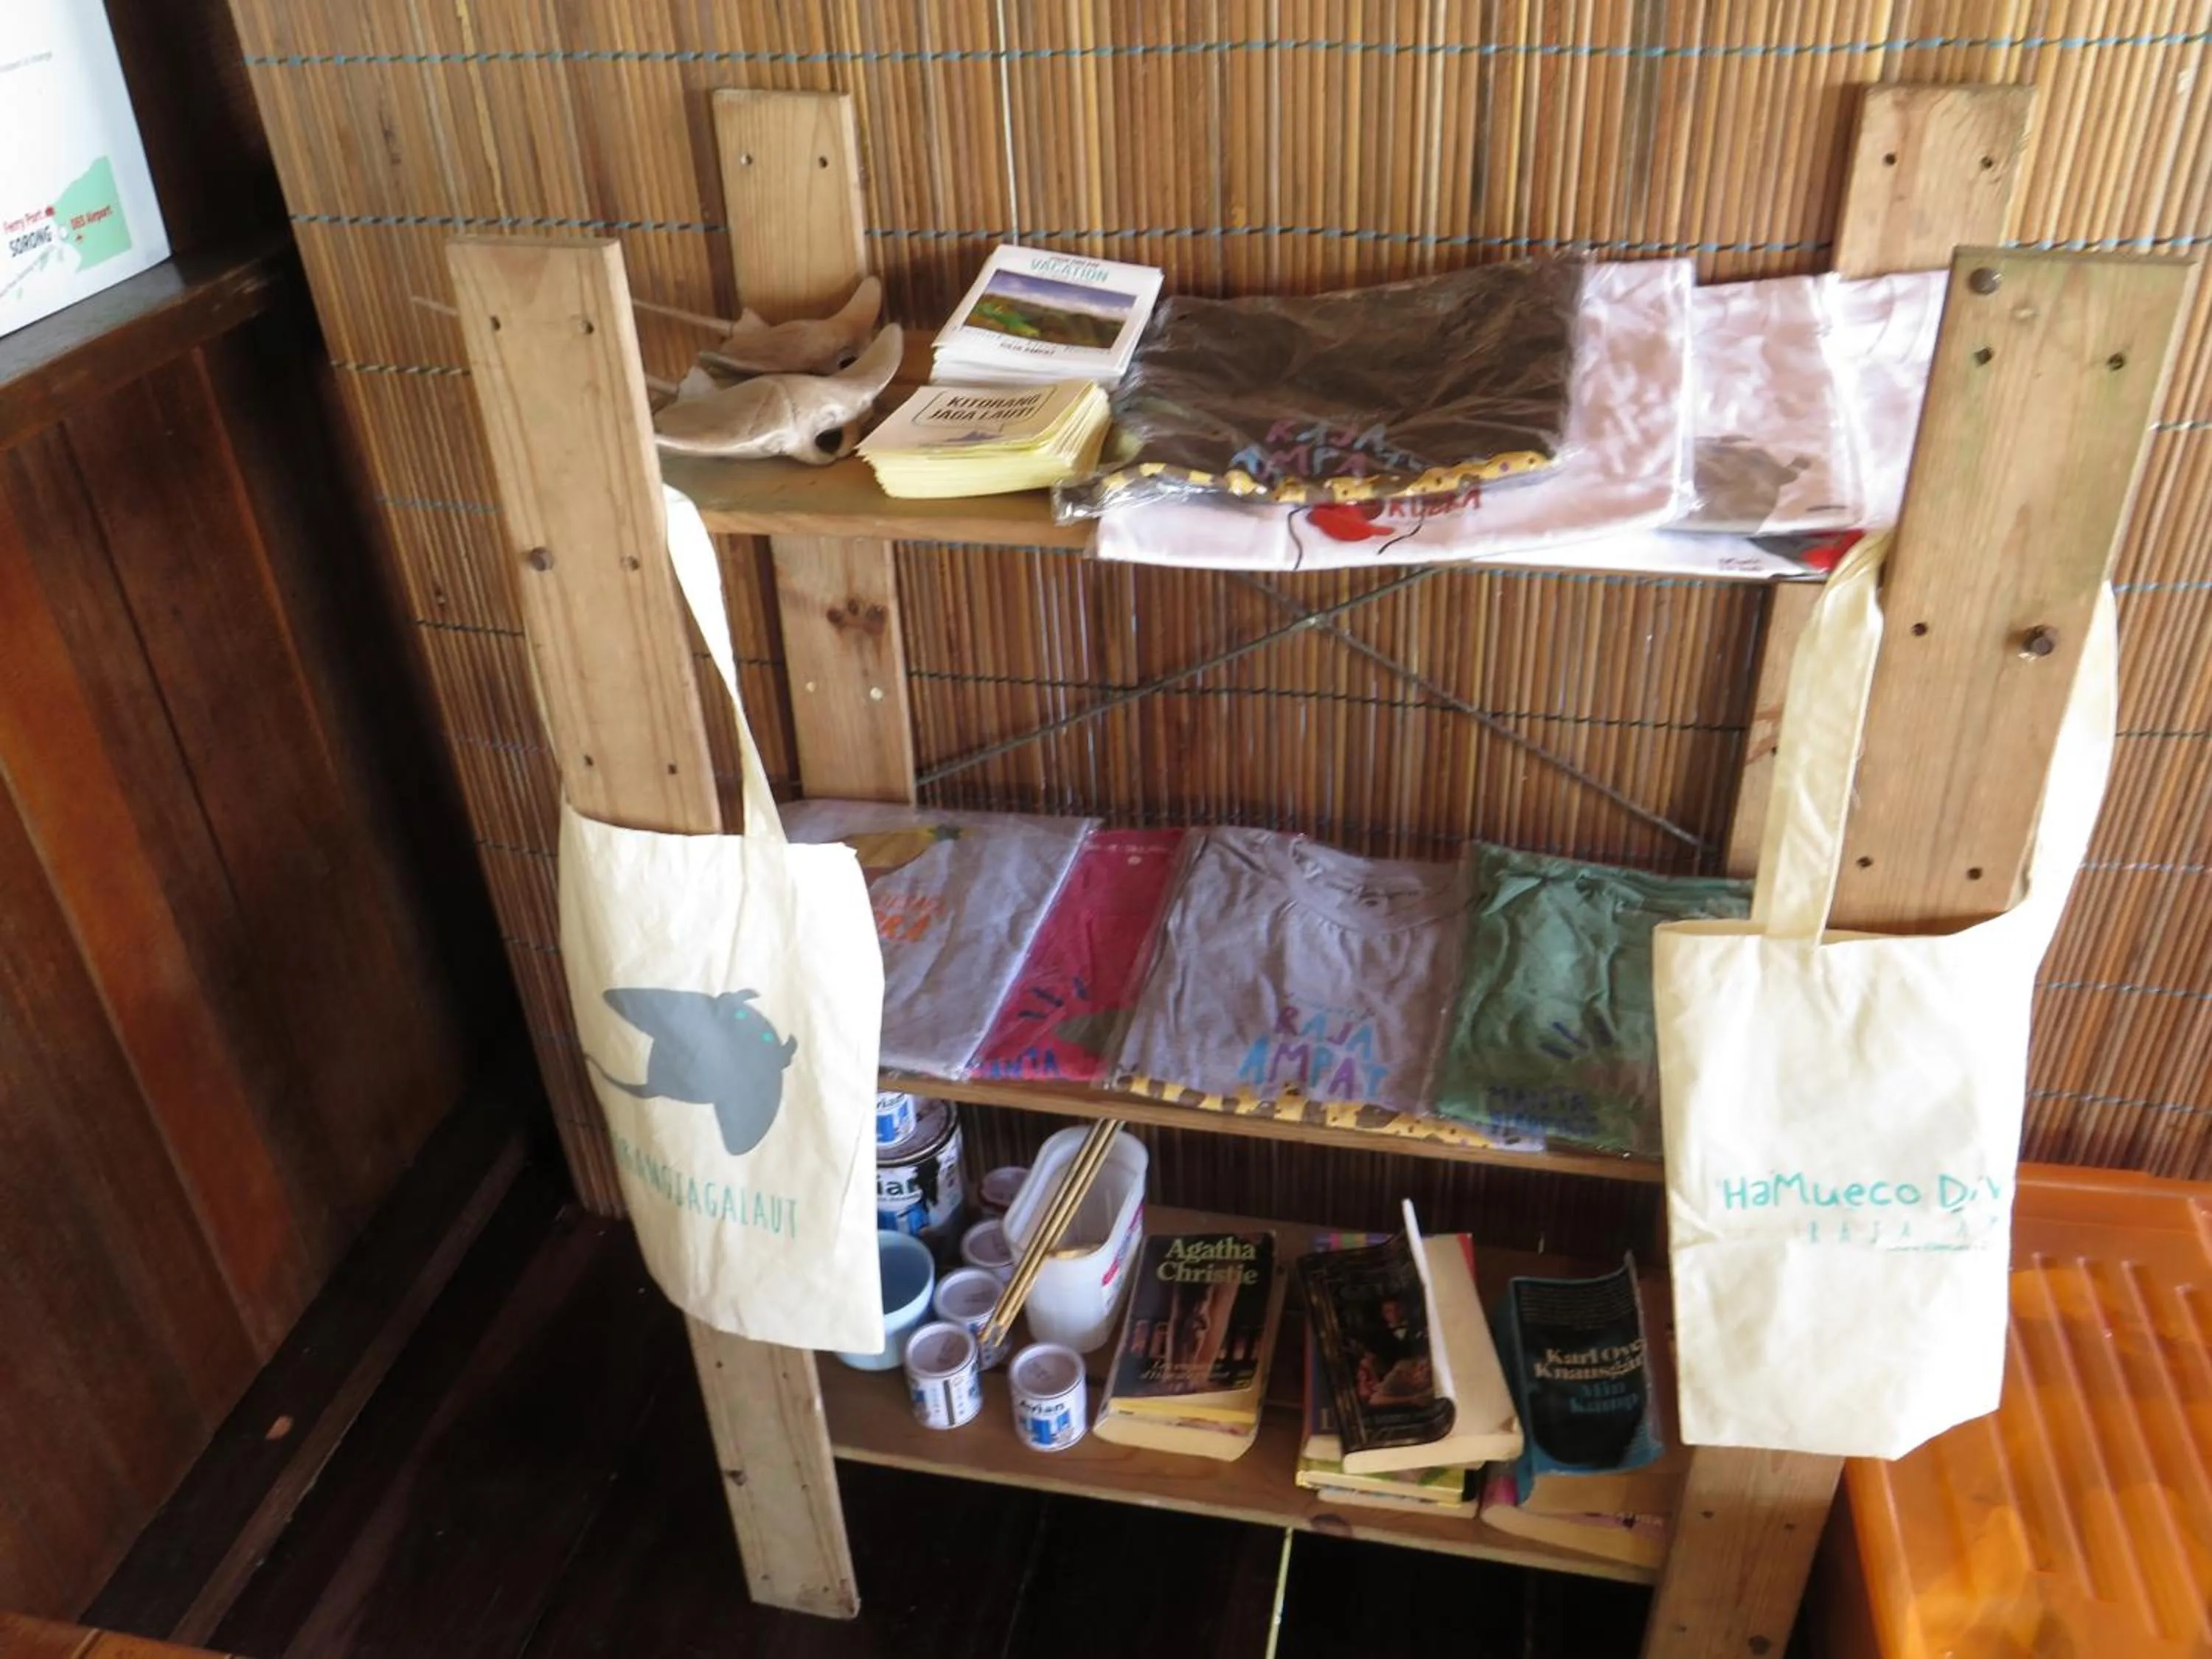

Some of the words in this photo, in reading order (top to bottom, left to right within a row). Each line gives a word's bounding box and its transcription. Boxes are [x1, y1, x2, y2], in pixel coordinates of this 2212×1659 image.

[9, 225, 52, 258] SORONG
[1031, 258, 1109, 282] VACATION
[1265, 418, 1388, 448] RAJA
[1275, 1006, 1372, 1061] RAJA
[1237, 1034, 1390, 1100] AMPAT
[1164, 1237, 1257, 1263] Agatha
[1156, 1260, 1259, 1285] Christie
[1545, 1348, 1599, 1364] Karl
